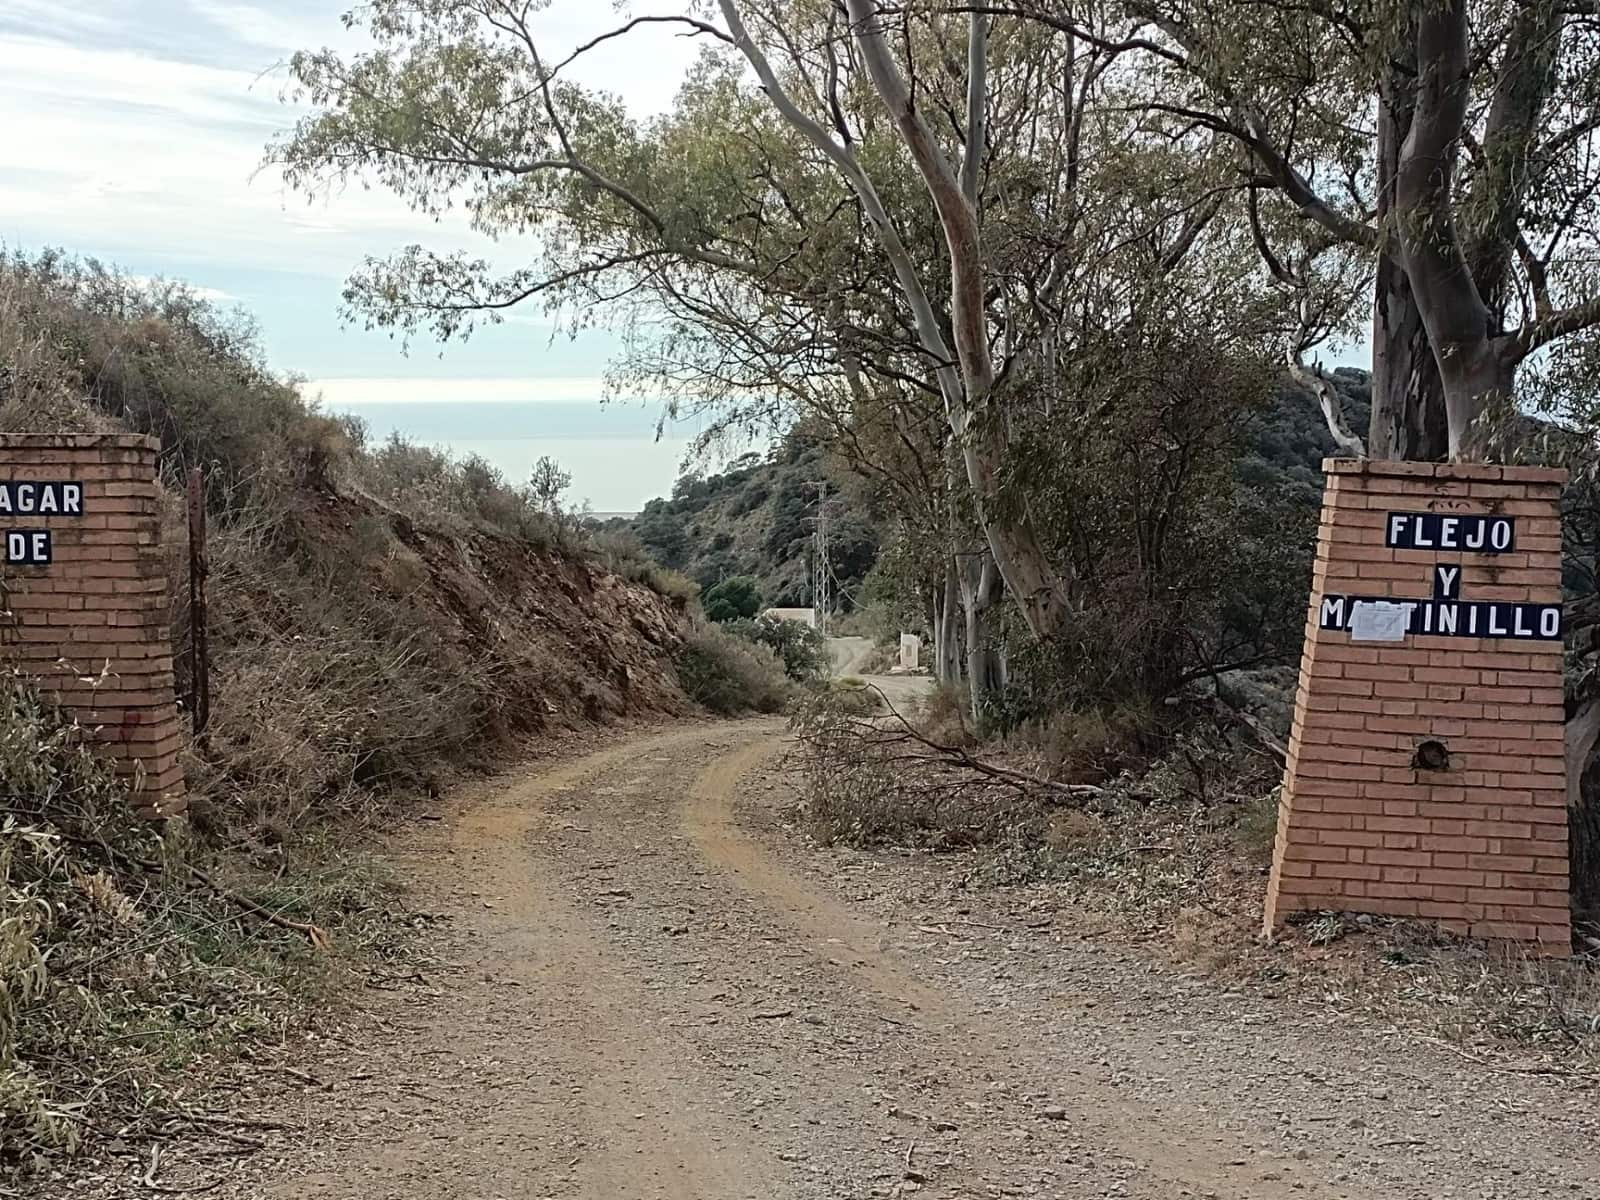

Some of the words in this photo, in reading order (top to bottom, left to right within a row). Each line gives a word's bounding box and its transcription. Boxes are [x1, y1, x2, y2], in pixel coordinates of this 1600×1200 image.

[9, 533, 48, 561] DE
[1390, 516, 1511, 550] FLEJO
[1438, 566, 1458, 597] Y
[1321, 598, 1560, 637] MTINILLO
